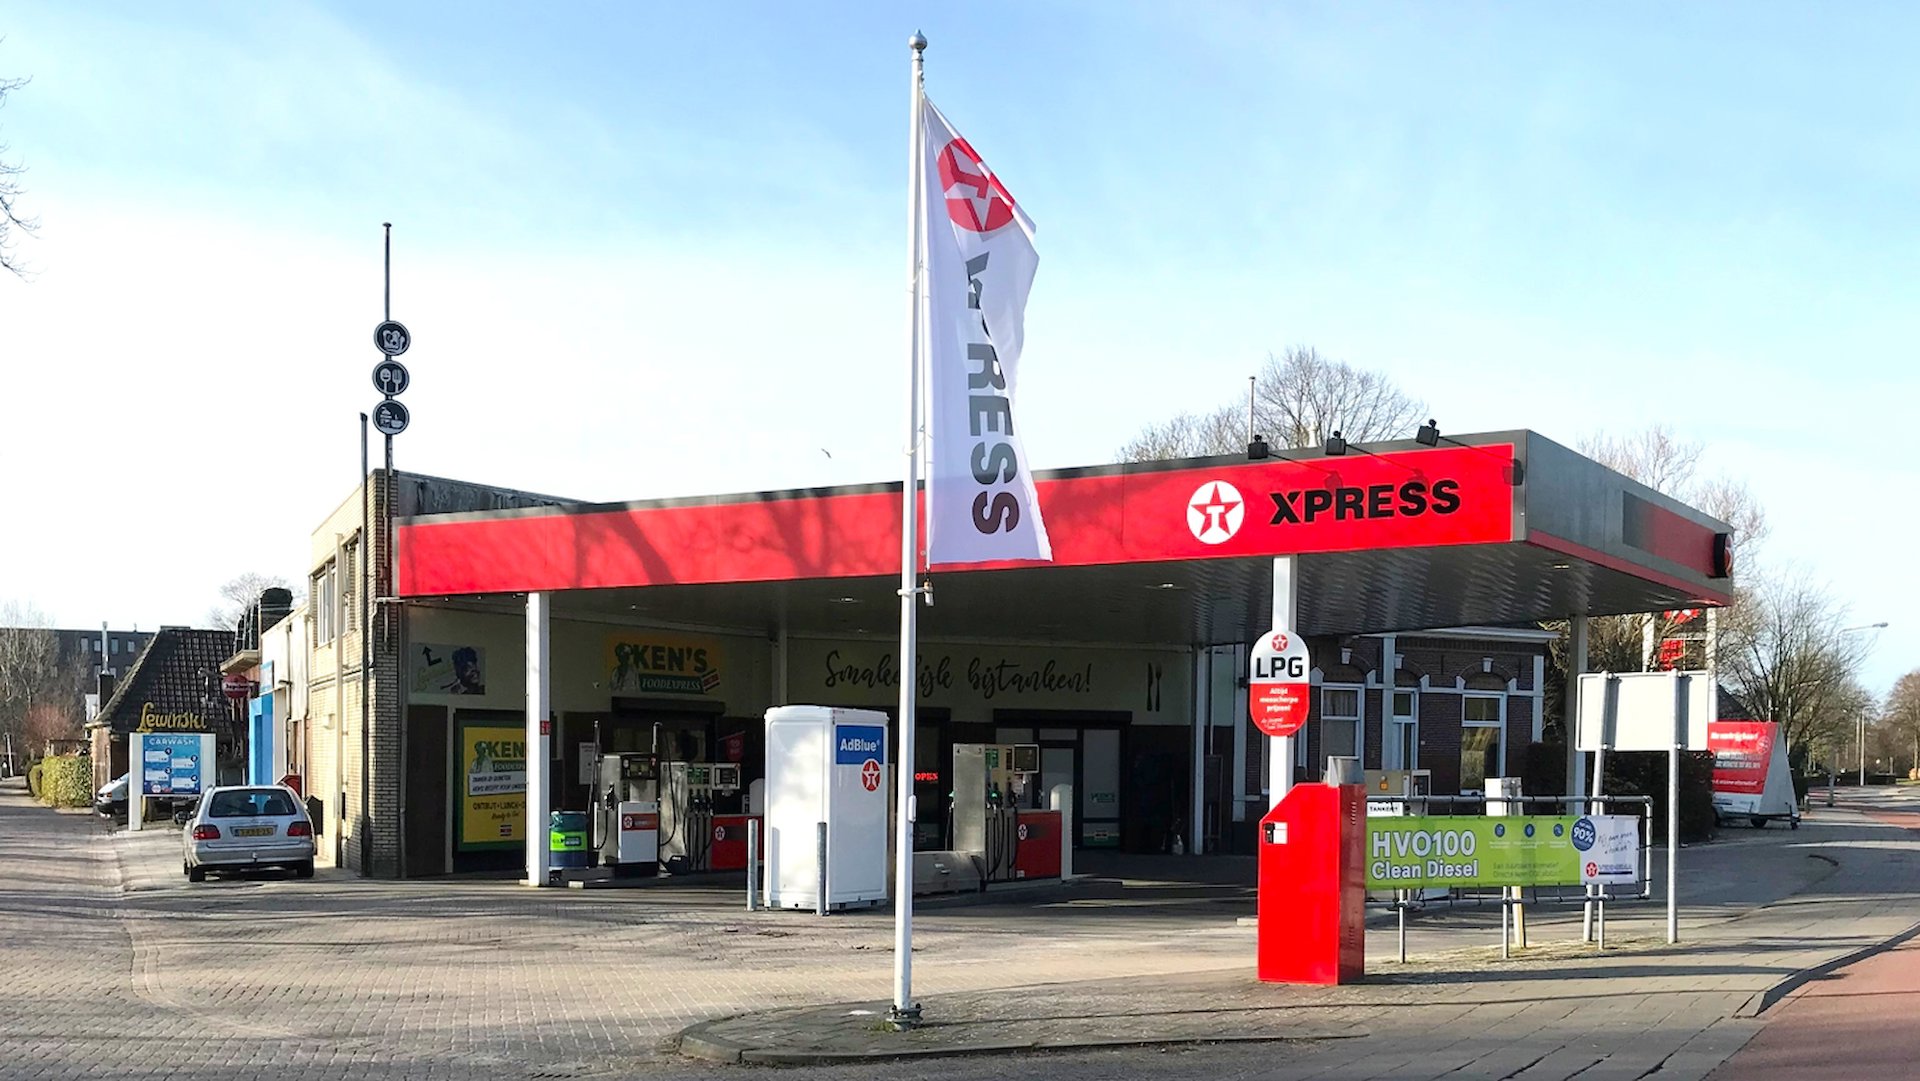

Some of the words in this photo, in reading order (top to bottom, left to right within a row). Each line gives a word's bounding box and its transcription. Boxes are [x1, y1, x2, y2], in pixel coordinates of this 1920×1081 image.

[1269, 480, 1461, 525] XPRESS
[633, 644, 708, 673] KEN'S
[1256, 656, 1304, 678] LPG
[641, 677, 700, 690] FOODEXPRESS
[967, 656, 1093, 700] bijtanken!
[136, 702, 207, 733] Lewinski
[148, 737, 195, 746] CARWASH
[488, 741, 525, 758] KEN
[1372, 830, 1477, 858] HVO100
[1573, 826, 1594, 843] 90%
[1371, 860, 1422, 880] Clean
[1426, 858, 1480, 878] Diesel
